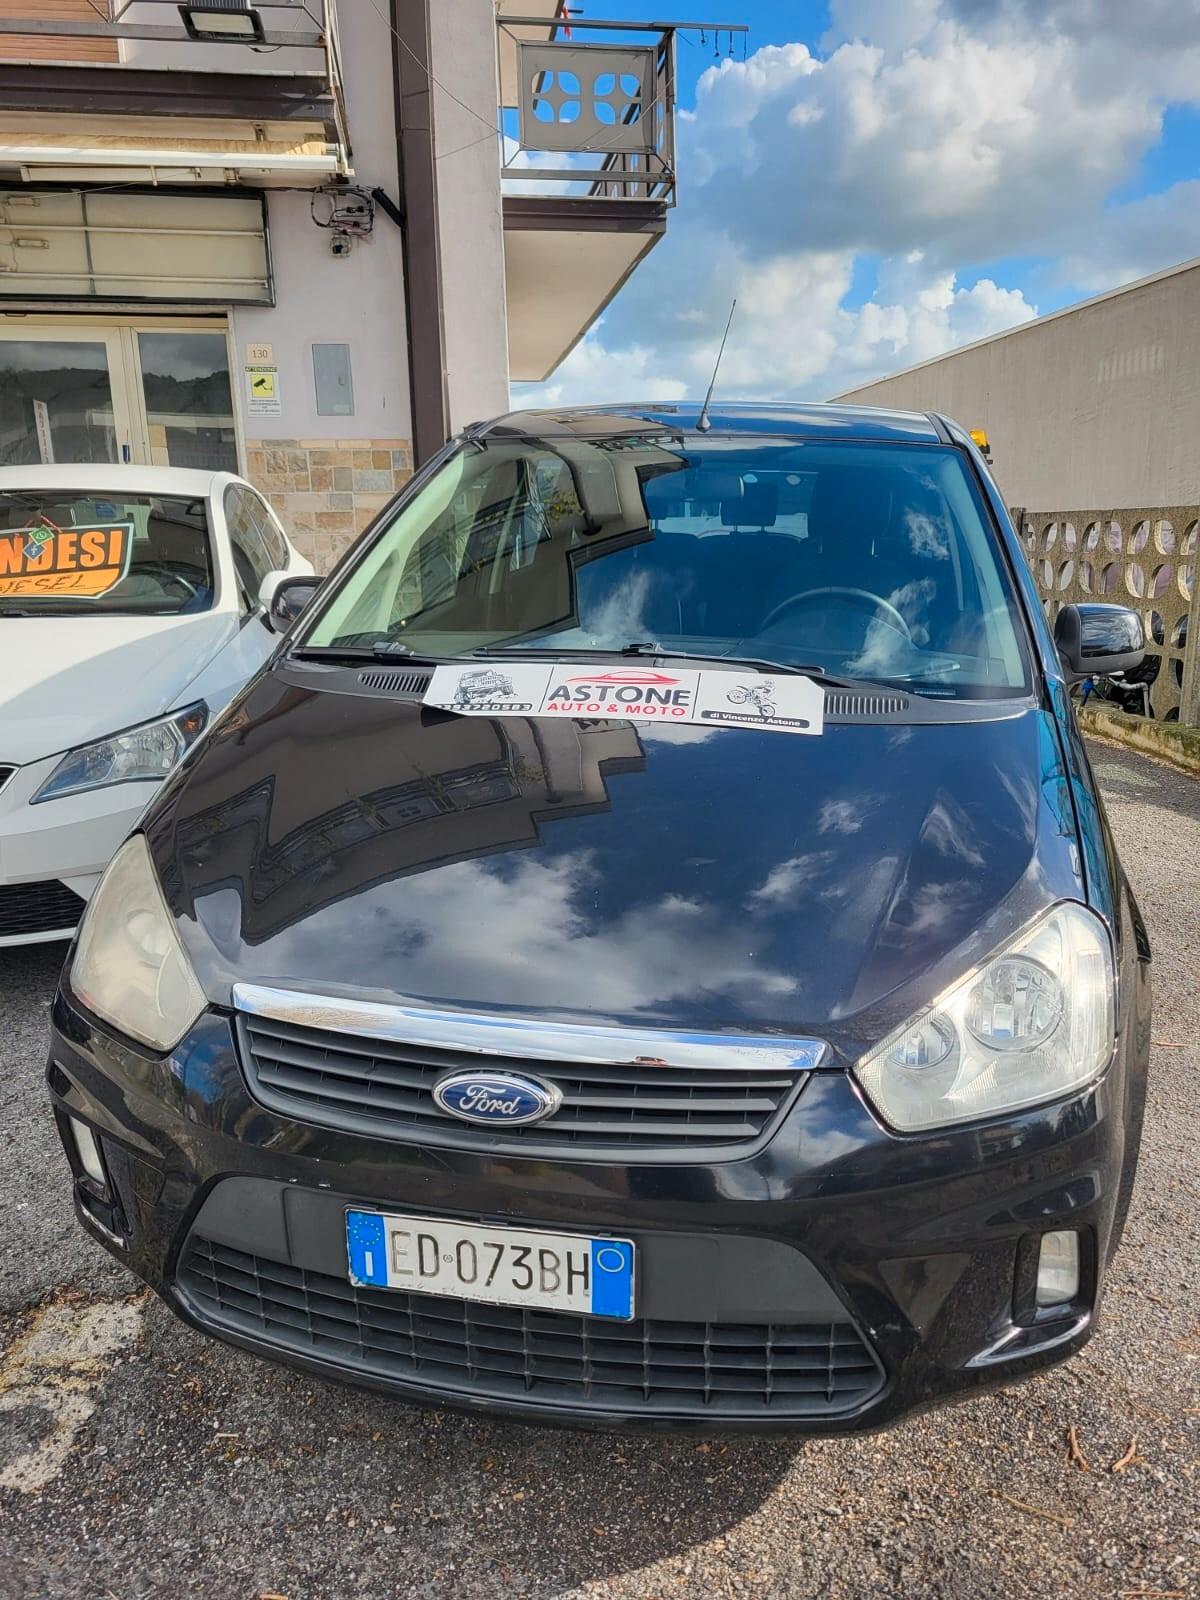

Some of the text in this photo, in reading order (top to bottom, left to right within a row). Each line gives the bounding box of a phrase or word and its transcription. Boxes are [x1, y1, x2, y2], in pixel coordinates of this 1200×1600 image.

[252, 350, 268, 358] 130
[548, 685, 691, 707] ASTONE
[547, 703, 686, 716] AUTO & MOTO
[722, 713, 765, 723] Vincenzo
[766, 718, 801, 727] Astone
[459, 1085, 521, 1115] Ford
